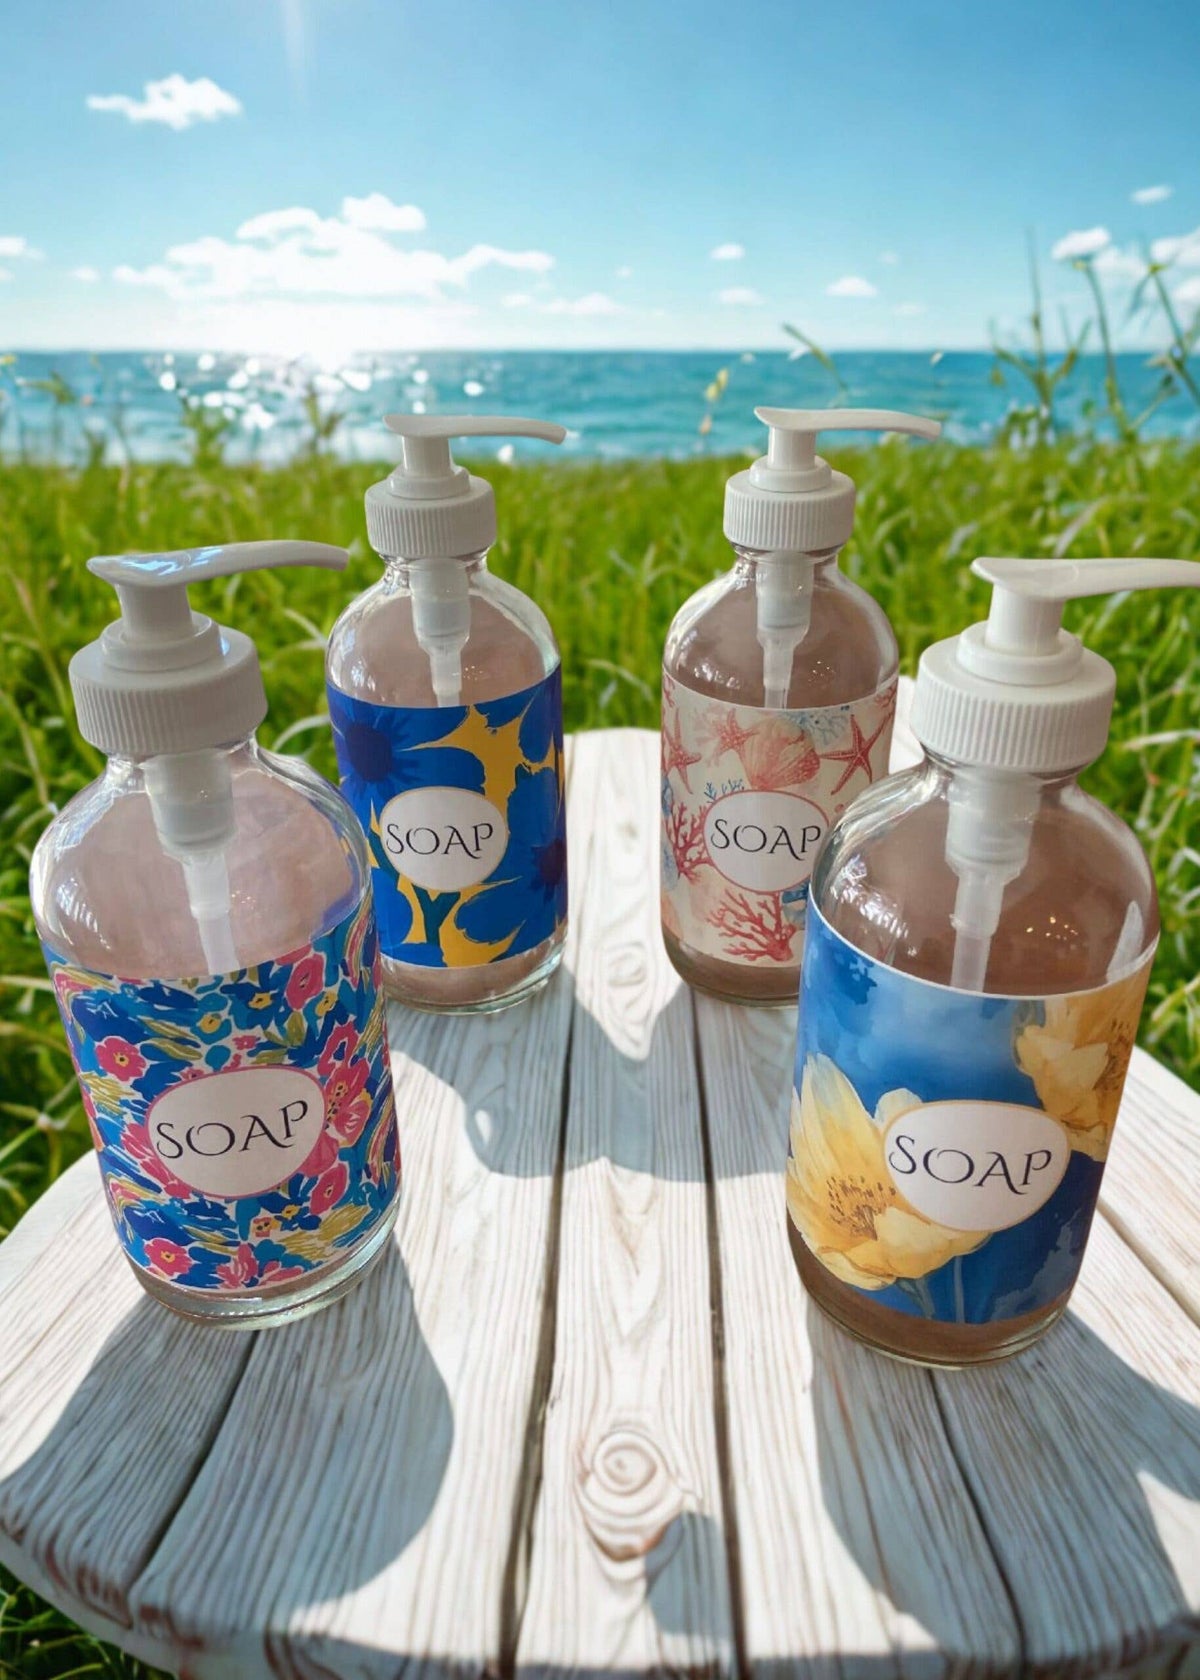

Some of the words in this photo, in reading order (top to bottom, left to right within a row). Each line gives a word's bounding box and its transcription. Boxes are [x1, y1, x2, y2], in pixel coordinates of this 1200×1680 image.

[386, 822, 494, 860] SOAP
[710, 818, 821, 861] SOAP
[156, 1100, 308, 1159] SOAP
[888, 1135, 1052, 1195] SOAP
